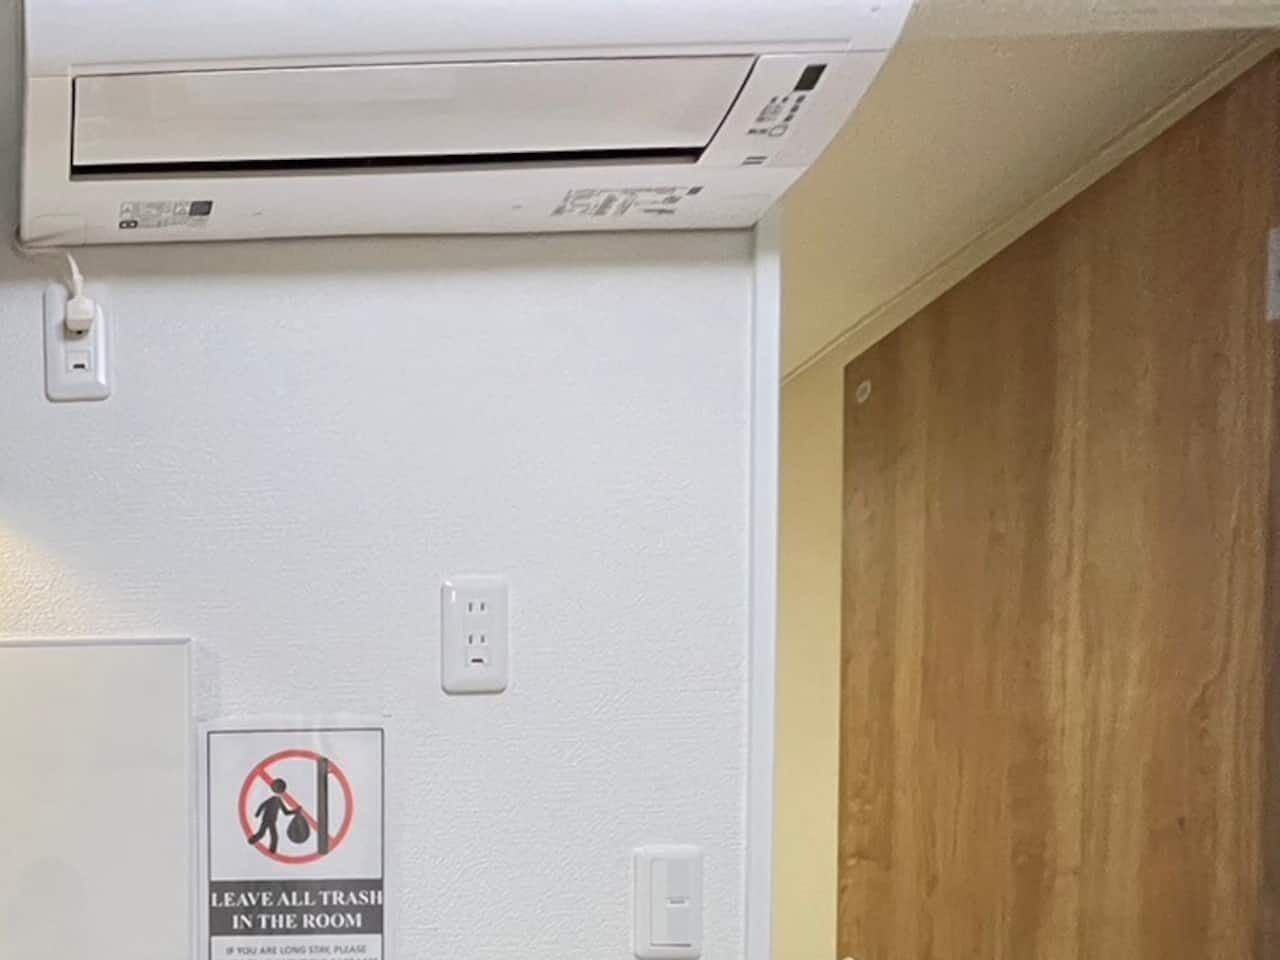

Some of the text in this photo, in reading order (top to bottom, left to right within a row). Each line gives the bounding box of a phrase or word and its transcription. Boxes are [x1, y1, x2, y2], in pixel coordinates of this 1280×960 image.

[211, 890, 383, 907] LEAVE ALL TRASH
[232, 912, 363, 930] IN THE ROOM
[226, 946, 234, 955] IF
[237, 946, 256, 955] YOU
[260, 946, 277, 955] ARE
[280, 945, 306, 955] LONG
[334, 944, 366, 954] PLEASE
